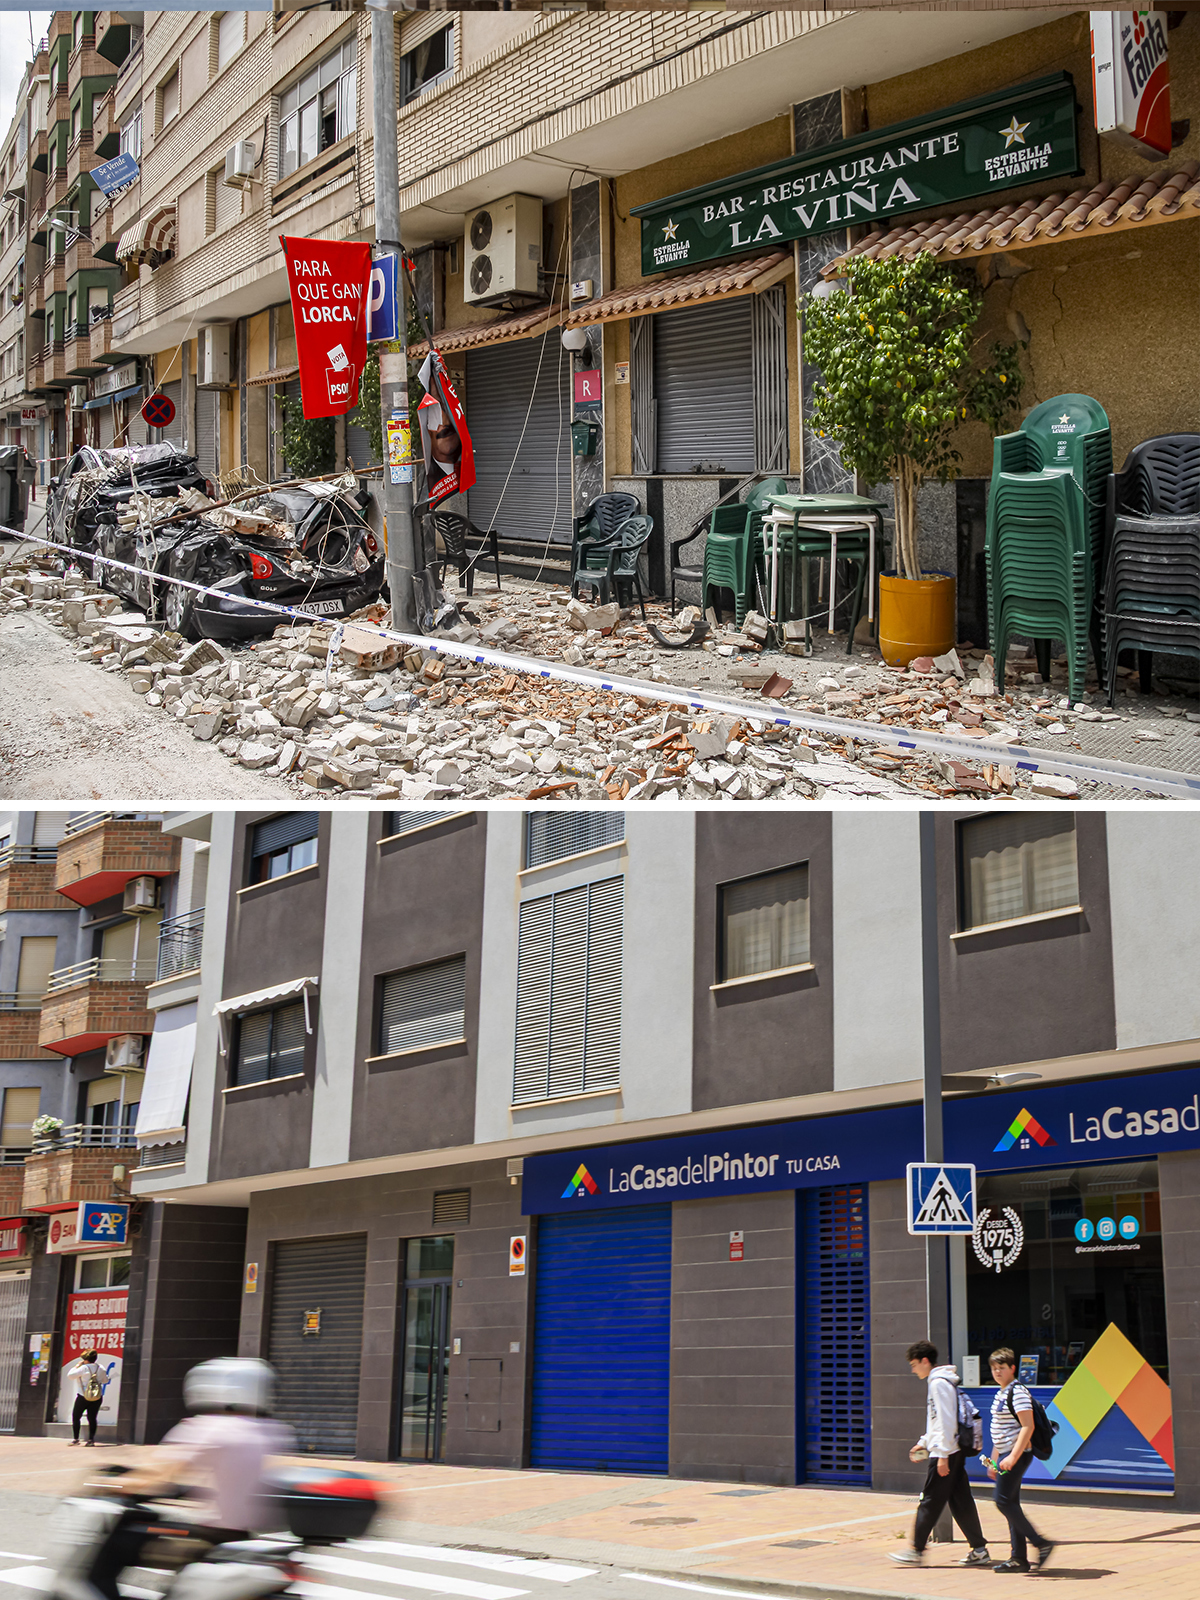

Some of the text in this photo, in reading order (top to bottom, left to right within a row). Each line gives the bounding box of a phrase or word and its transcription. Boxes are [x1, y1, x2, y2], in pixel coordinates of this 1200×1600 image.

[1123, 18, 1168, 99] Fanta
[984, 142, 1053, 171] ESTRELLA
[98, 168, 106, 176] Se
[106, 157, 126, 170] Vende
[989, 155, 1049, 181] LEVANTE
[703, 196, 745, 223] BAR
[762, 132, 960, 206] RESTAURANTE
[729, 177, 921, 248] LA VIÑA
[653, 239, 690, 258] ESTRELLA
[655, 250, 688, 265] LEVANTE
[294, 260, 332, 276] PARA
[297, 283, 363, 302] QUE GAN
[367, 267, 386, 333] P
[302, 306, 356, 324] LORCA.
[331, 352, 346, 365] VOTA
[582, 379, 592, 397] R
[323, 601, 341, 612] DSX
[609, 1152, 841, 1193] LaCasadelPintor TU CASA
[88, 1212, 123, 1235] CAP
[986, 1219, 1008, 1229] DESDE
[982, 1229, 1015, 1248] 1975
[72, 1299, 98, 1316] CURSOS
[96, 1333, 107, 1349] 77
[107, 1332, 119, 1349] 52
